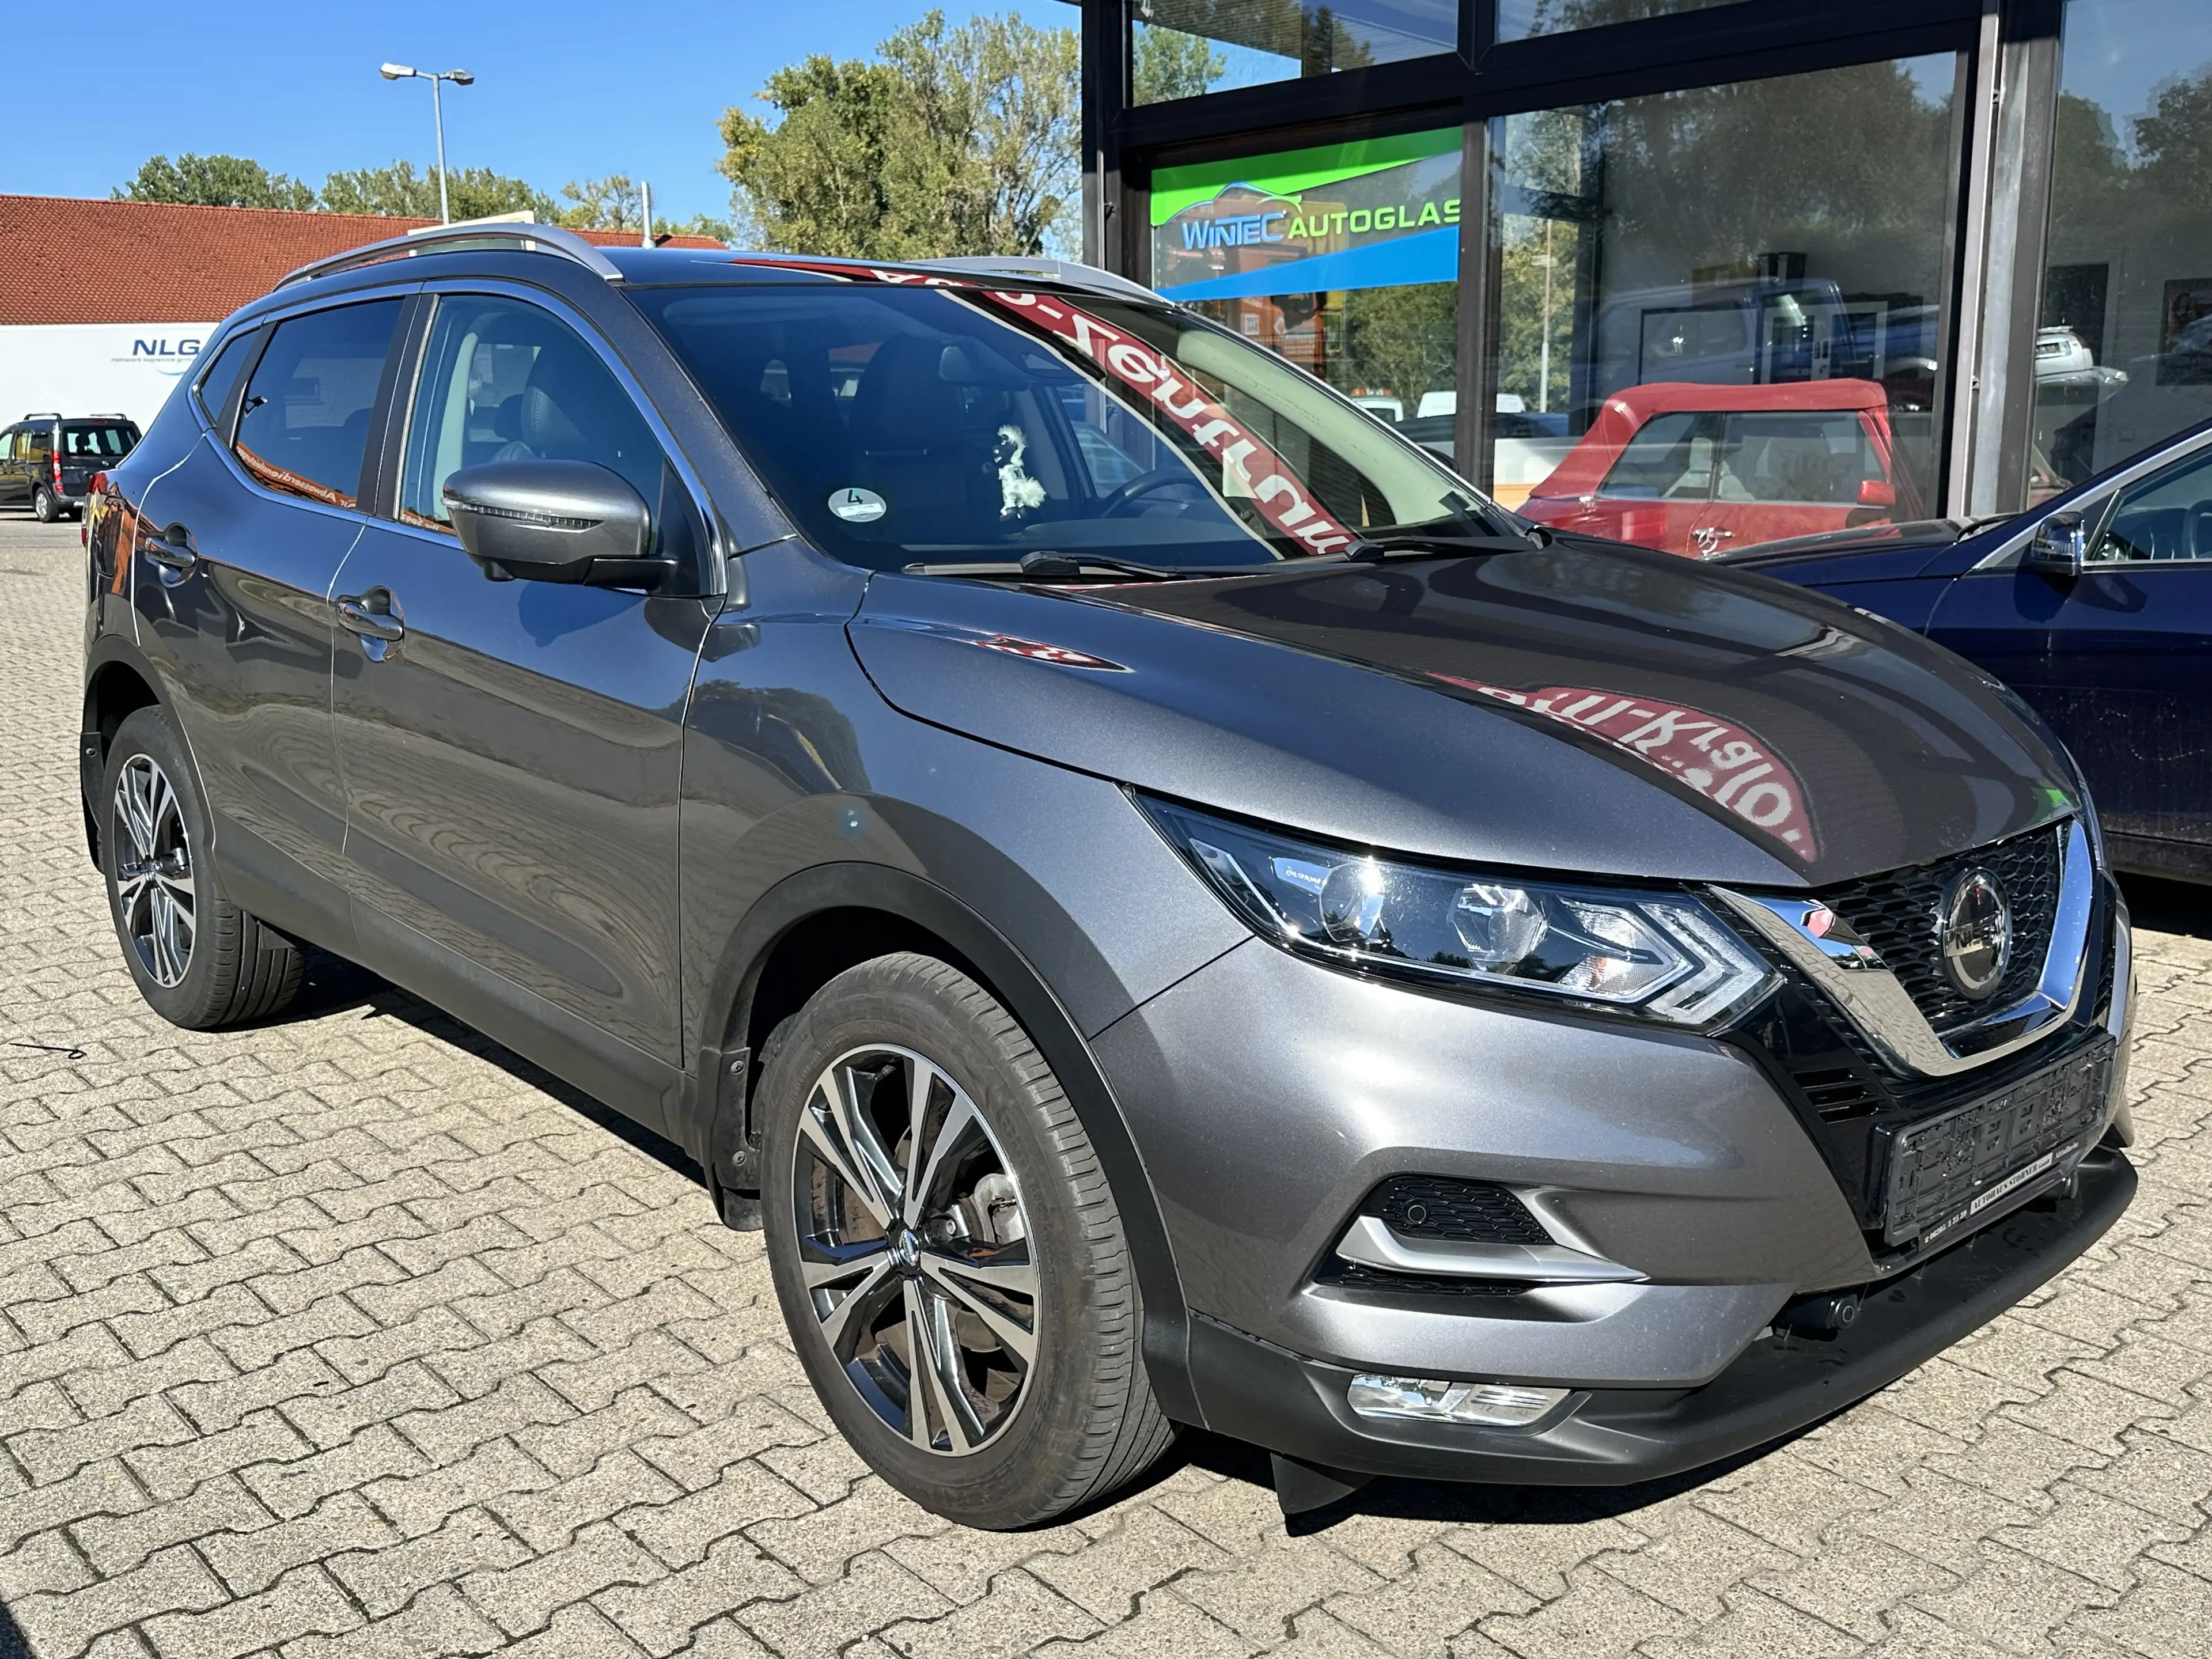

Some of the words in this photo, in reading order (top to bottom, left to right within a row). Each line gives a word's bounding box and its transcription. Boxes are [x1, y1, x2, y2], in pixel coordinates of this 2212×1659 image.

[1287, 199, 1461, 239] AUTOGLAS
[132, 339, 200, 355] NLG
[847, 489, 863, 504] 4
